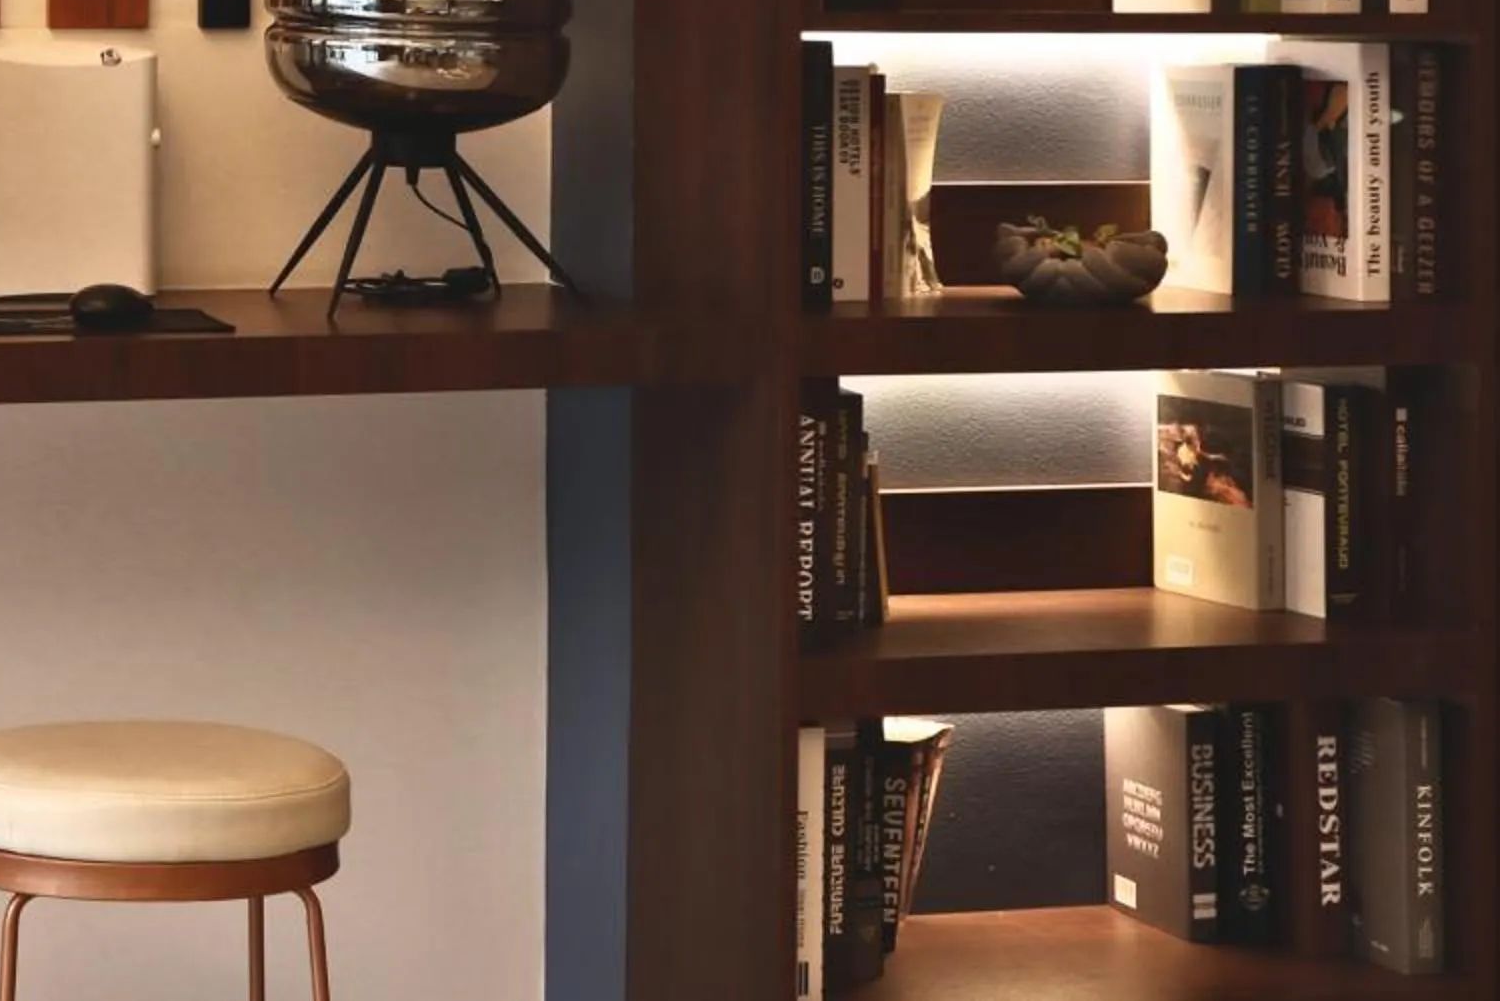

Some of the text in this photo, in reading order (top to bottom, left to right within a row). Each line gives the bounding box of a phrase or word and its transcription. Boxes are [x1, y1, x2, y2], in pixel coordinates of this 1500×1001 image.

[1365, 71, 1384, 277] The beauty and youth
[883, 777, 906, 924] SEVENTEEN
[1192, 744, 1216, 869] BUSINESS
[1242, 793, 1256, 839] Most
[1243, 842, 1256, 876] The
[1317, 735, 1341, 906] REDSTAR
[1416, 784, 1434, 896] KINFOLK
